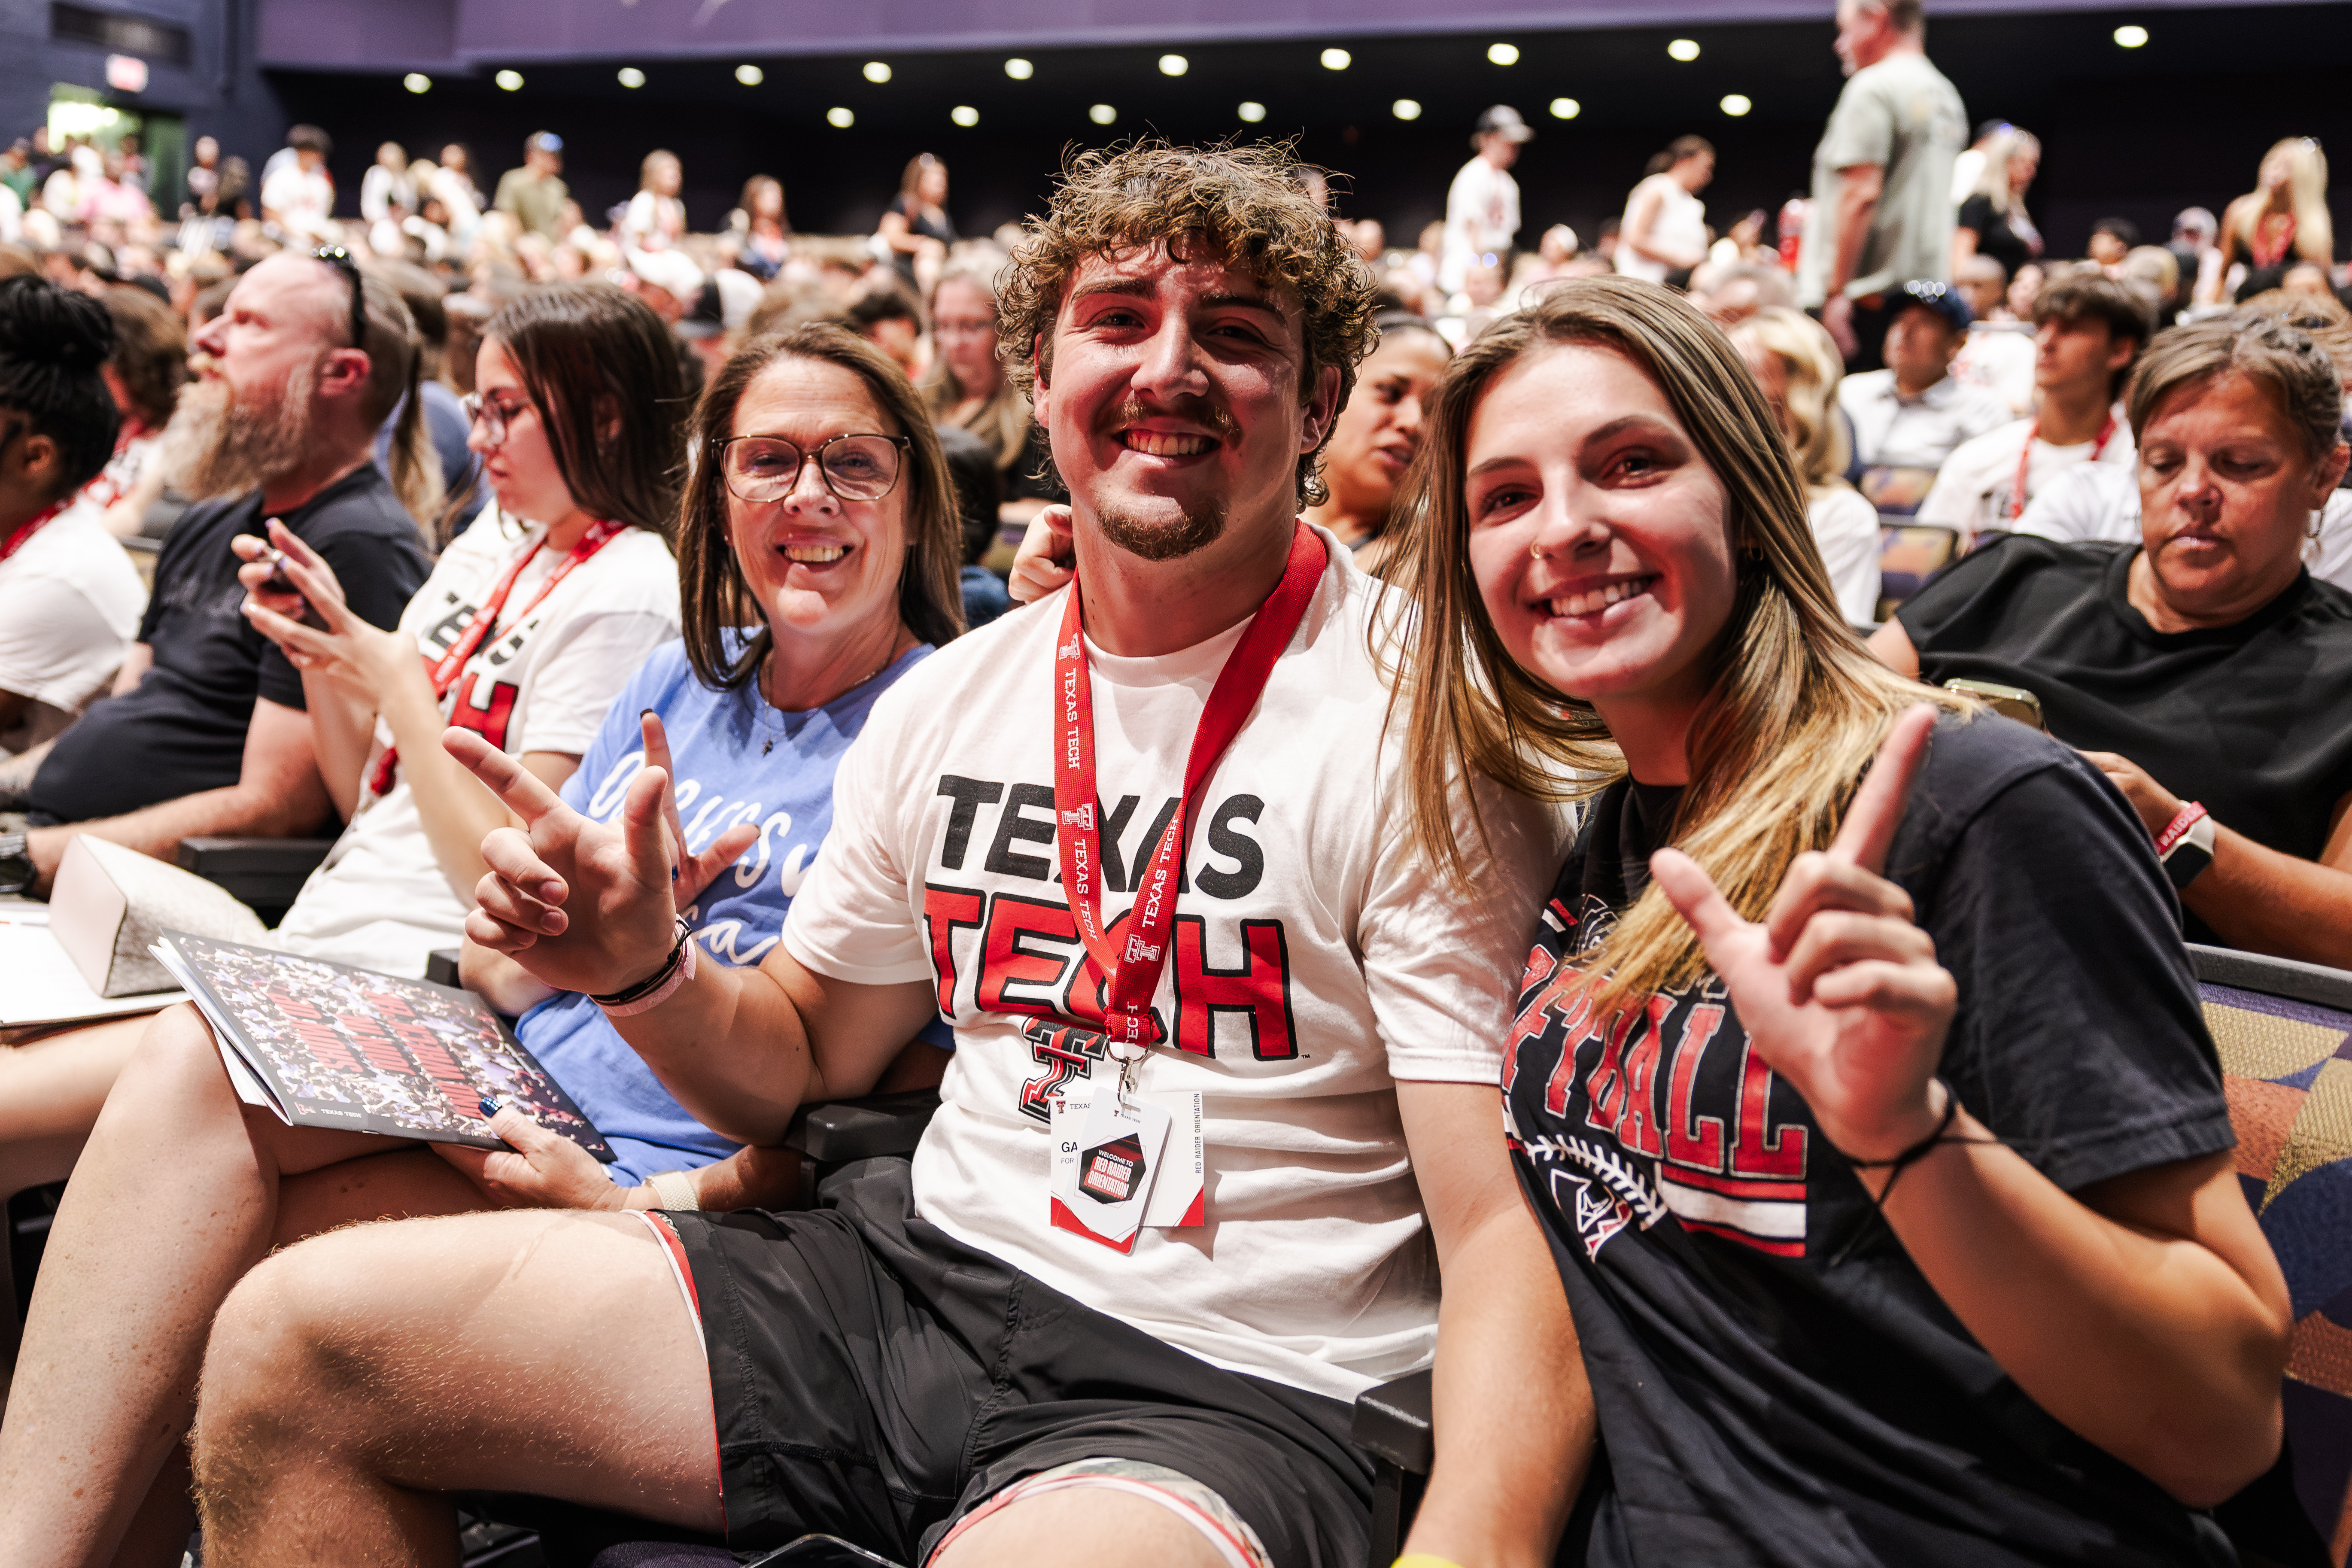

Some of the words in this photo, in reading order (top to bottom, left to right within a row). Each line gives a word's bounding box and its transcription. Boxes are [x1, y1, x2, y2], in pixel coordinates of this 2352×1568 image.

[1065, 668, 1078, 723] TEXAS
[1068, 726, 1080, 770] TECH
[1074, 839, 1089, 894] TEXAS
[1142, 869, 1167, 928] TEXAS
[1159, 816, 1179, 863] TECH
[1079, 900, 1099, 942] TECH
[1094, 1156, 1107, 1173] RED
[1106, 1161, 1132, 1182] RAIDER
[1098, 1150, 1125, 1164] WELCOME
[1087, 1170, 1130, 1198] ORIENTATION
